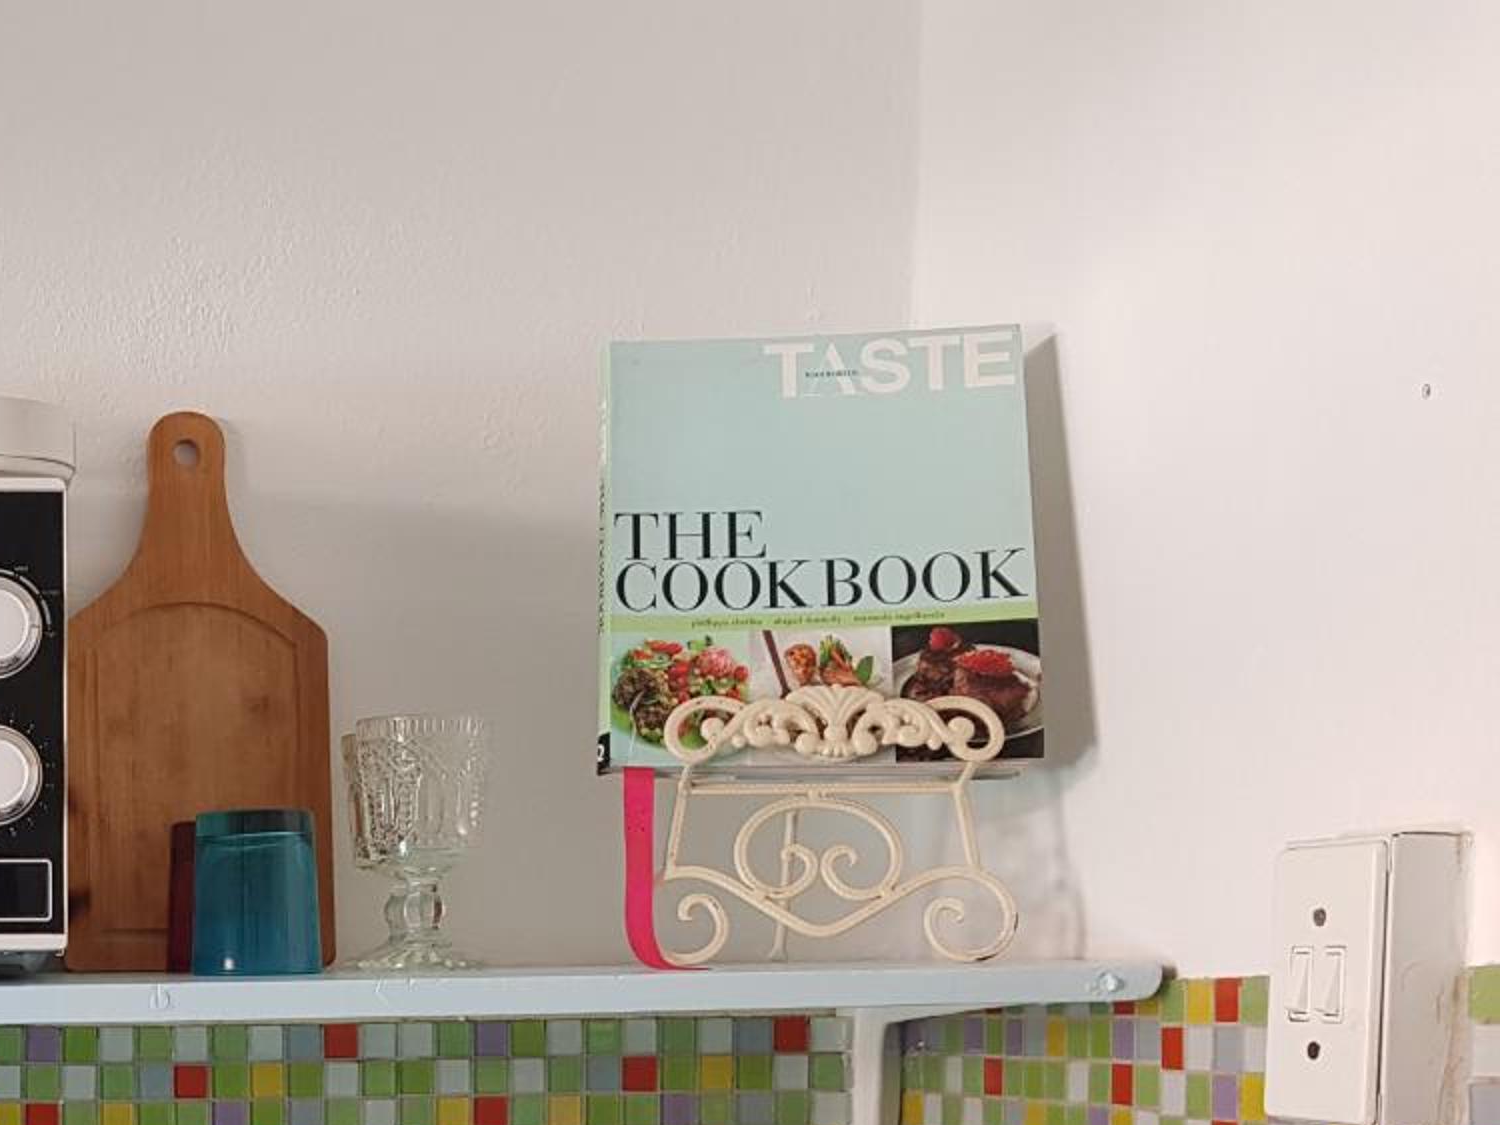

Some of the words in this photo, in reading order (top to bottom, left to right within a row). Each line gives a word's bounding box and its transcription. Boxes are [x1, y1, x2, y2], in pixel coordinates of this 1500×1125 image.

[762, 334, 1017, 399] TASTE
[613, 510, 767, 561] THE
[615, 547, 1030, 613] COOKBOOK
